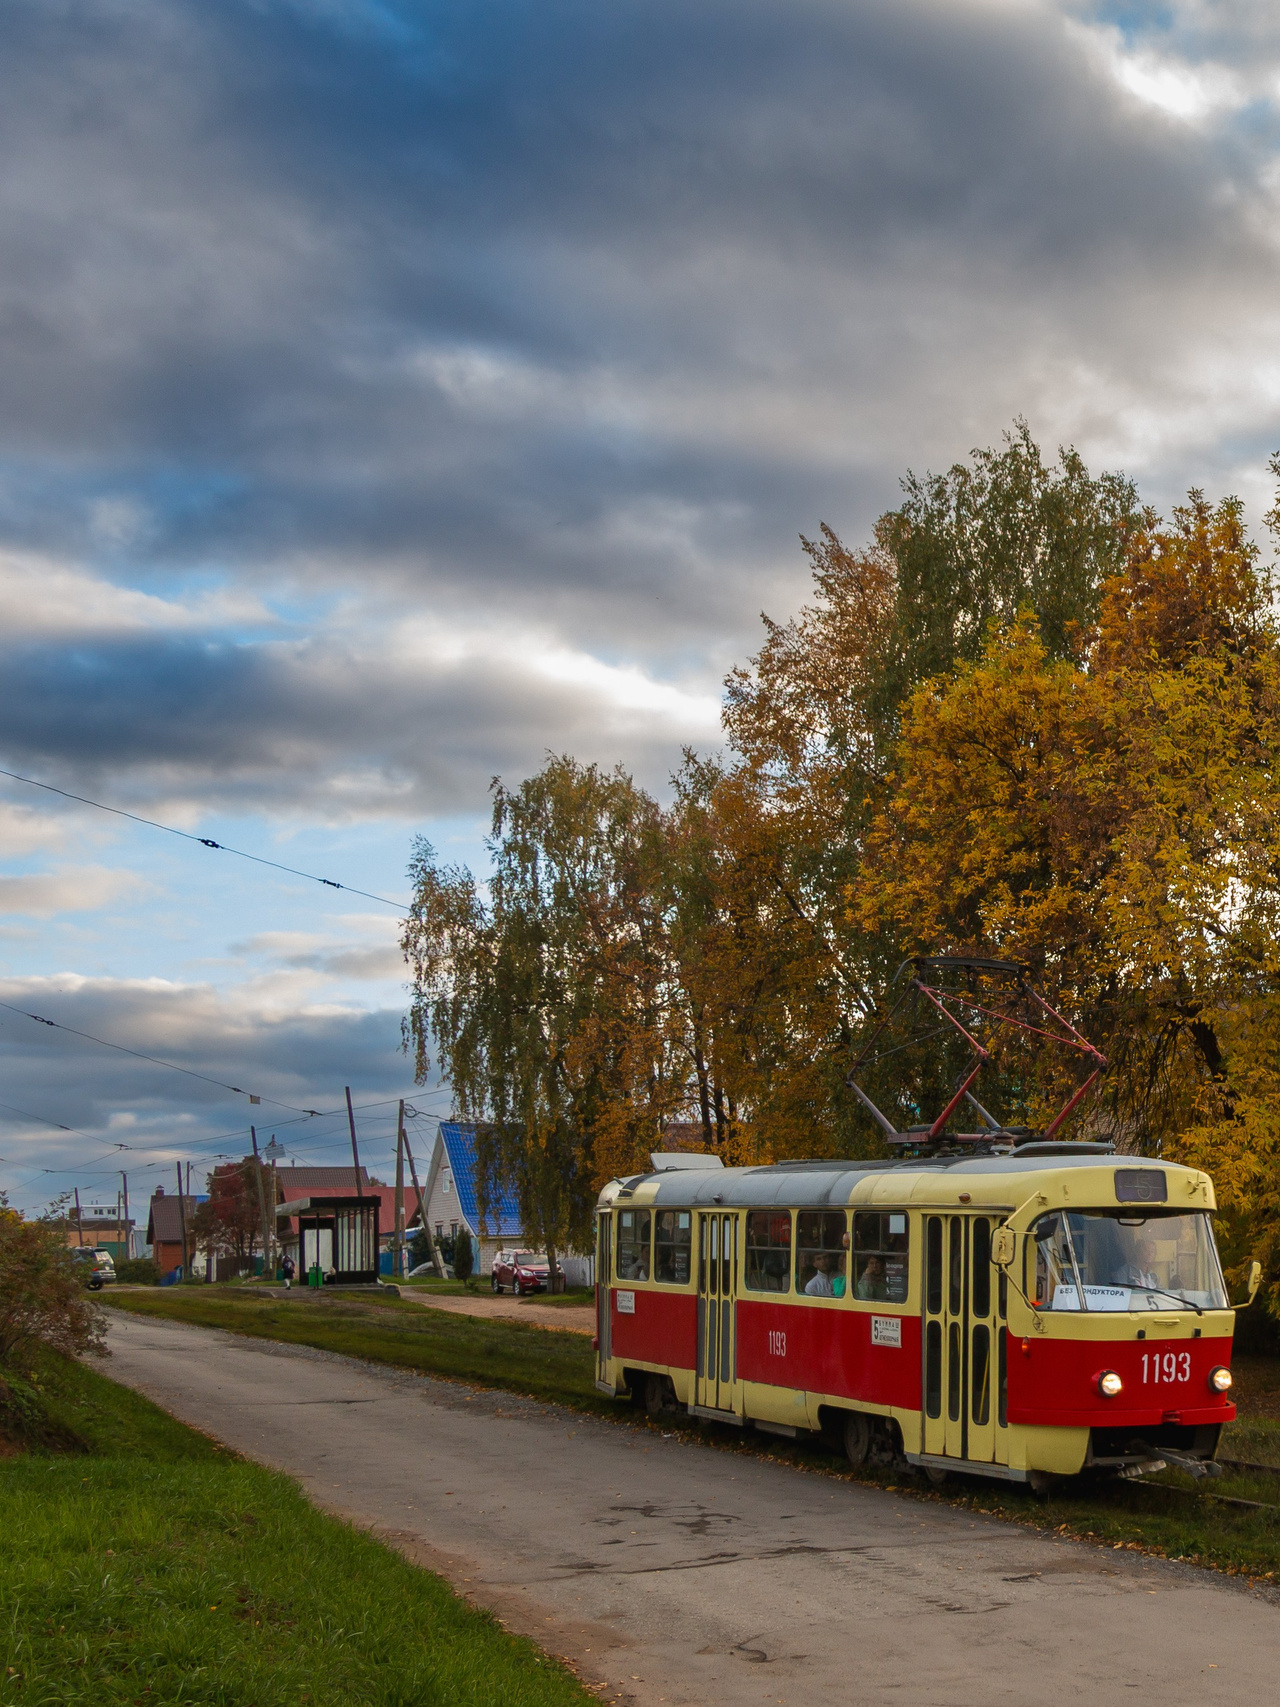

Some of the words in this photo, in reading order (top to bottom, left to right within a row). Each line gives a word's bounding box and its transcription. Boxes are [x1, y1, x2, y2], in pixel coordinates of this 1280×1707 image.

[1136, 1172, 1152, 1200] 5
[1059, 1287, 1073, 1295] БЕЗ
[1081, 1287, 1125, 1297] ОНДУКТОРА
[1146, 1295, 1159, 1310] 5
[874, 1319, 879, 1340] 5
[769, 1330, 787, 1357] 1193
[1141, 1352, 1191, 1384] 1193
